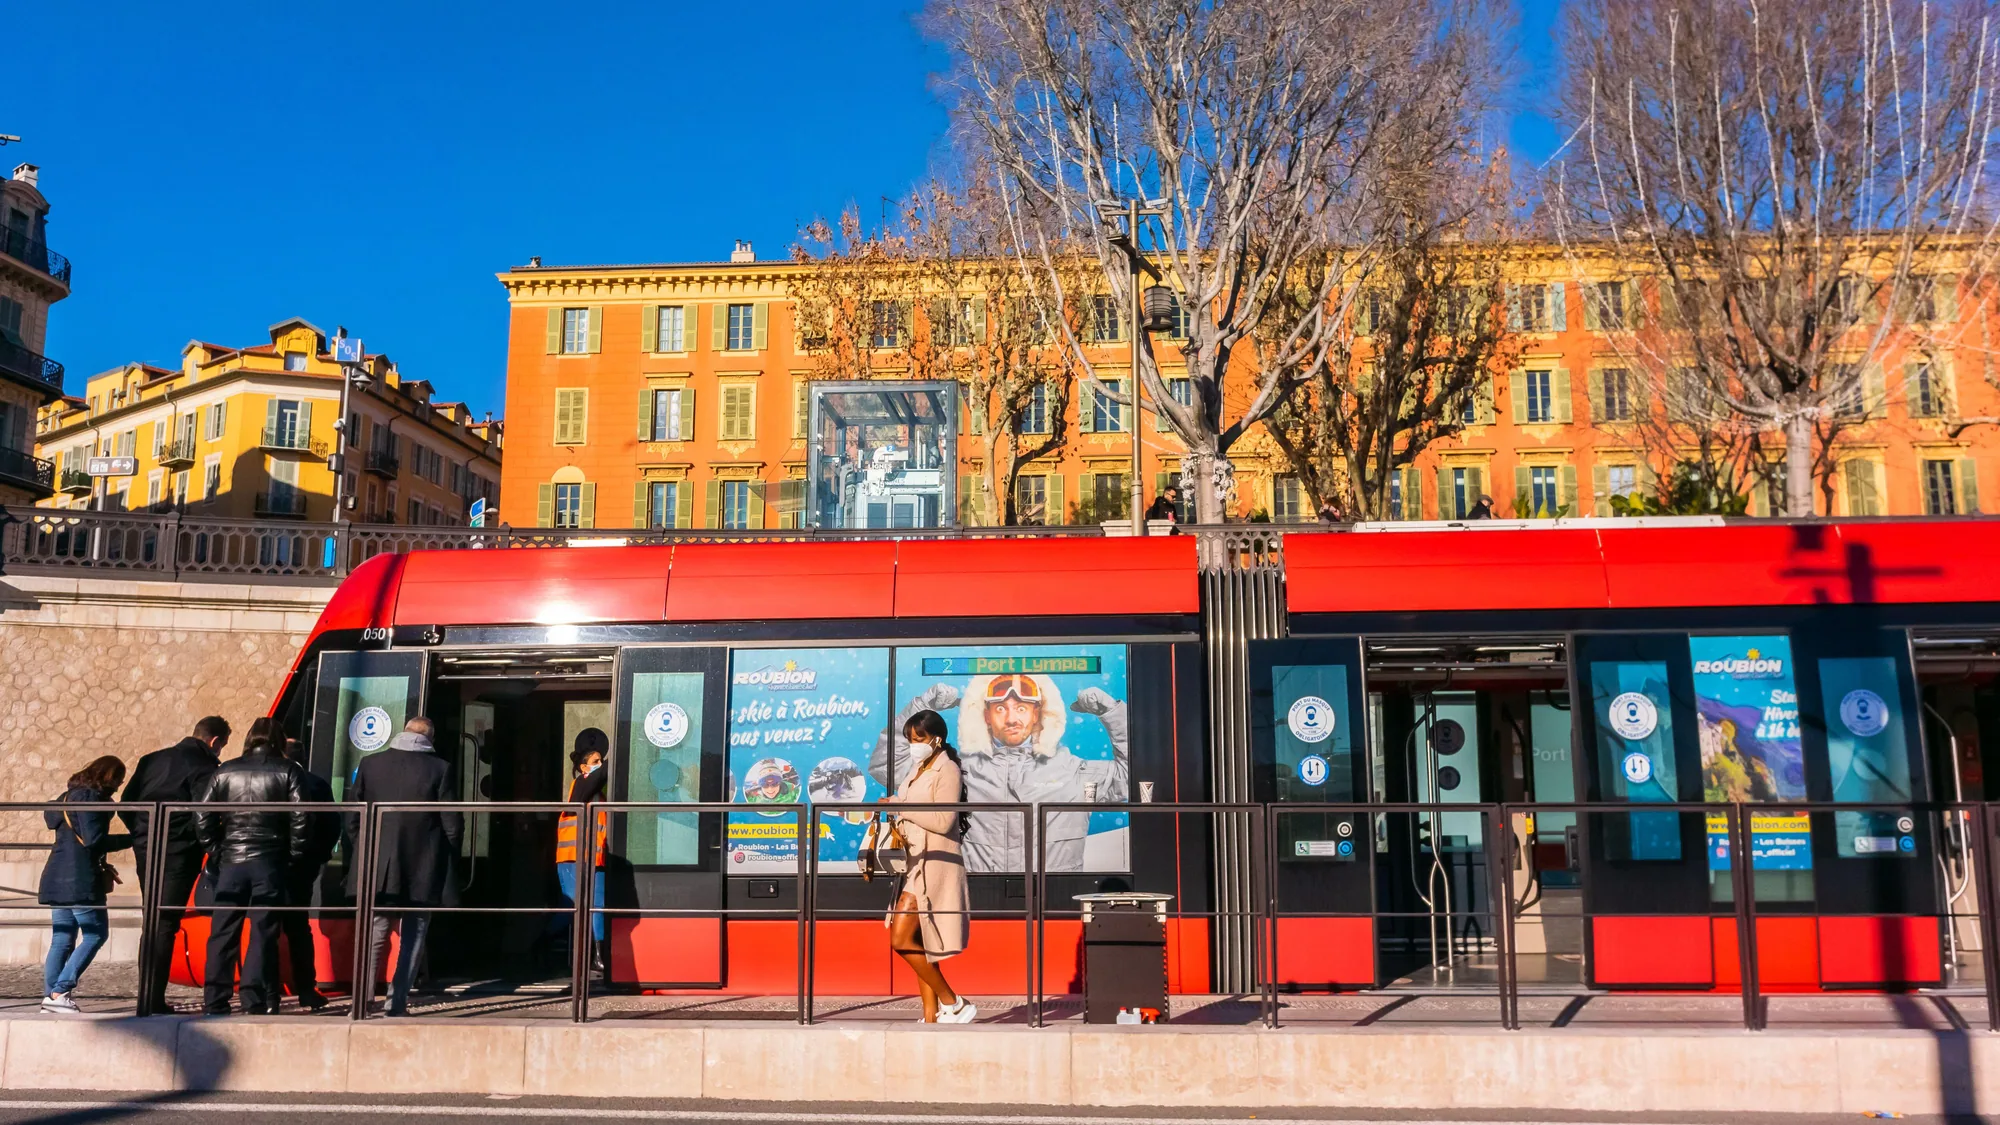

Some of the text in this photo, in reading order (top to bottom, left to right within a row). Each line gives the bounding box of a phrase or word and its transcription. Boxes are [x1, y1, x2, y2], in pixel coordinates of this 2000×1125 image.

[339, 339, 357, 361] SOS
[363, 628, 386, 640] 050
[942, 657, 1088, 673] 2 Port Lympia
[1694, 659, 1782, 674] ROUBION
[733, 671, 816, 685] ROUBION
[737, 700, 772, 723] skie
[776, 701, 788, 719] à
[793, 694, 870, 720] Roubion,
[1292, 701, 1302, 711] PORT
[1312, 698, 1330, 711] MASQUE
[730, 730, 760, 747] ous
[764, 727, 814, 744] venez
[1295, 731, 1328, 740] OBLIGATOIRE
